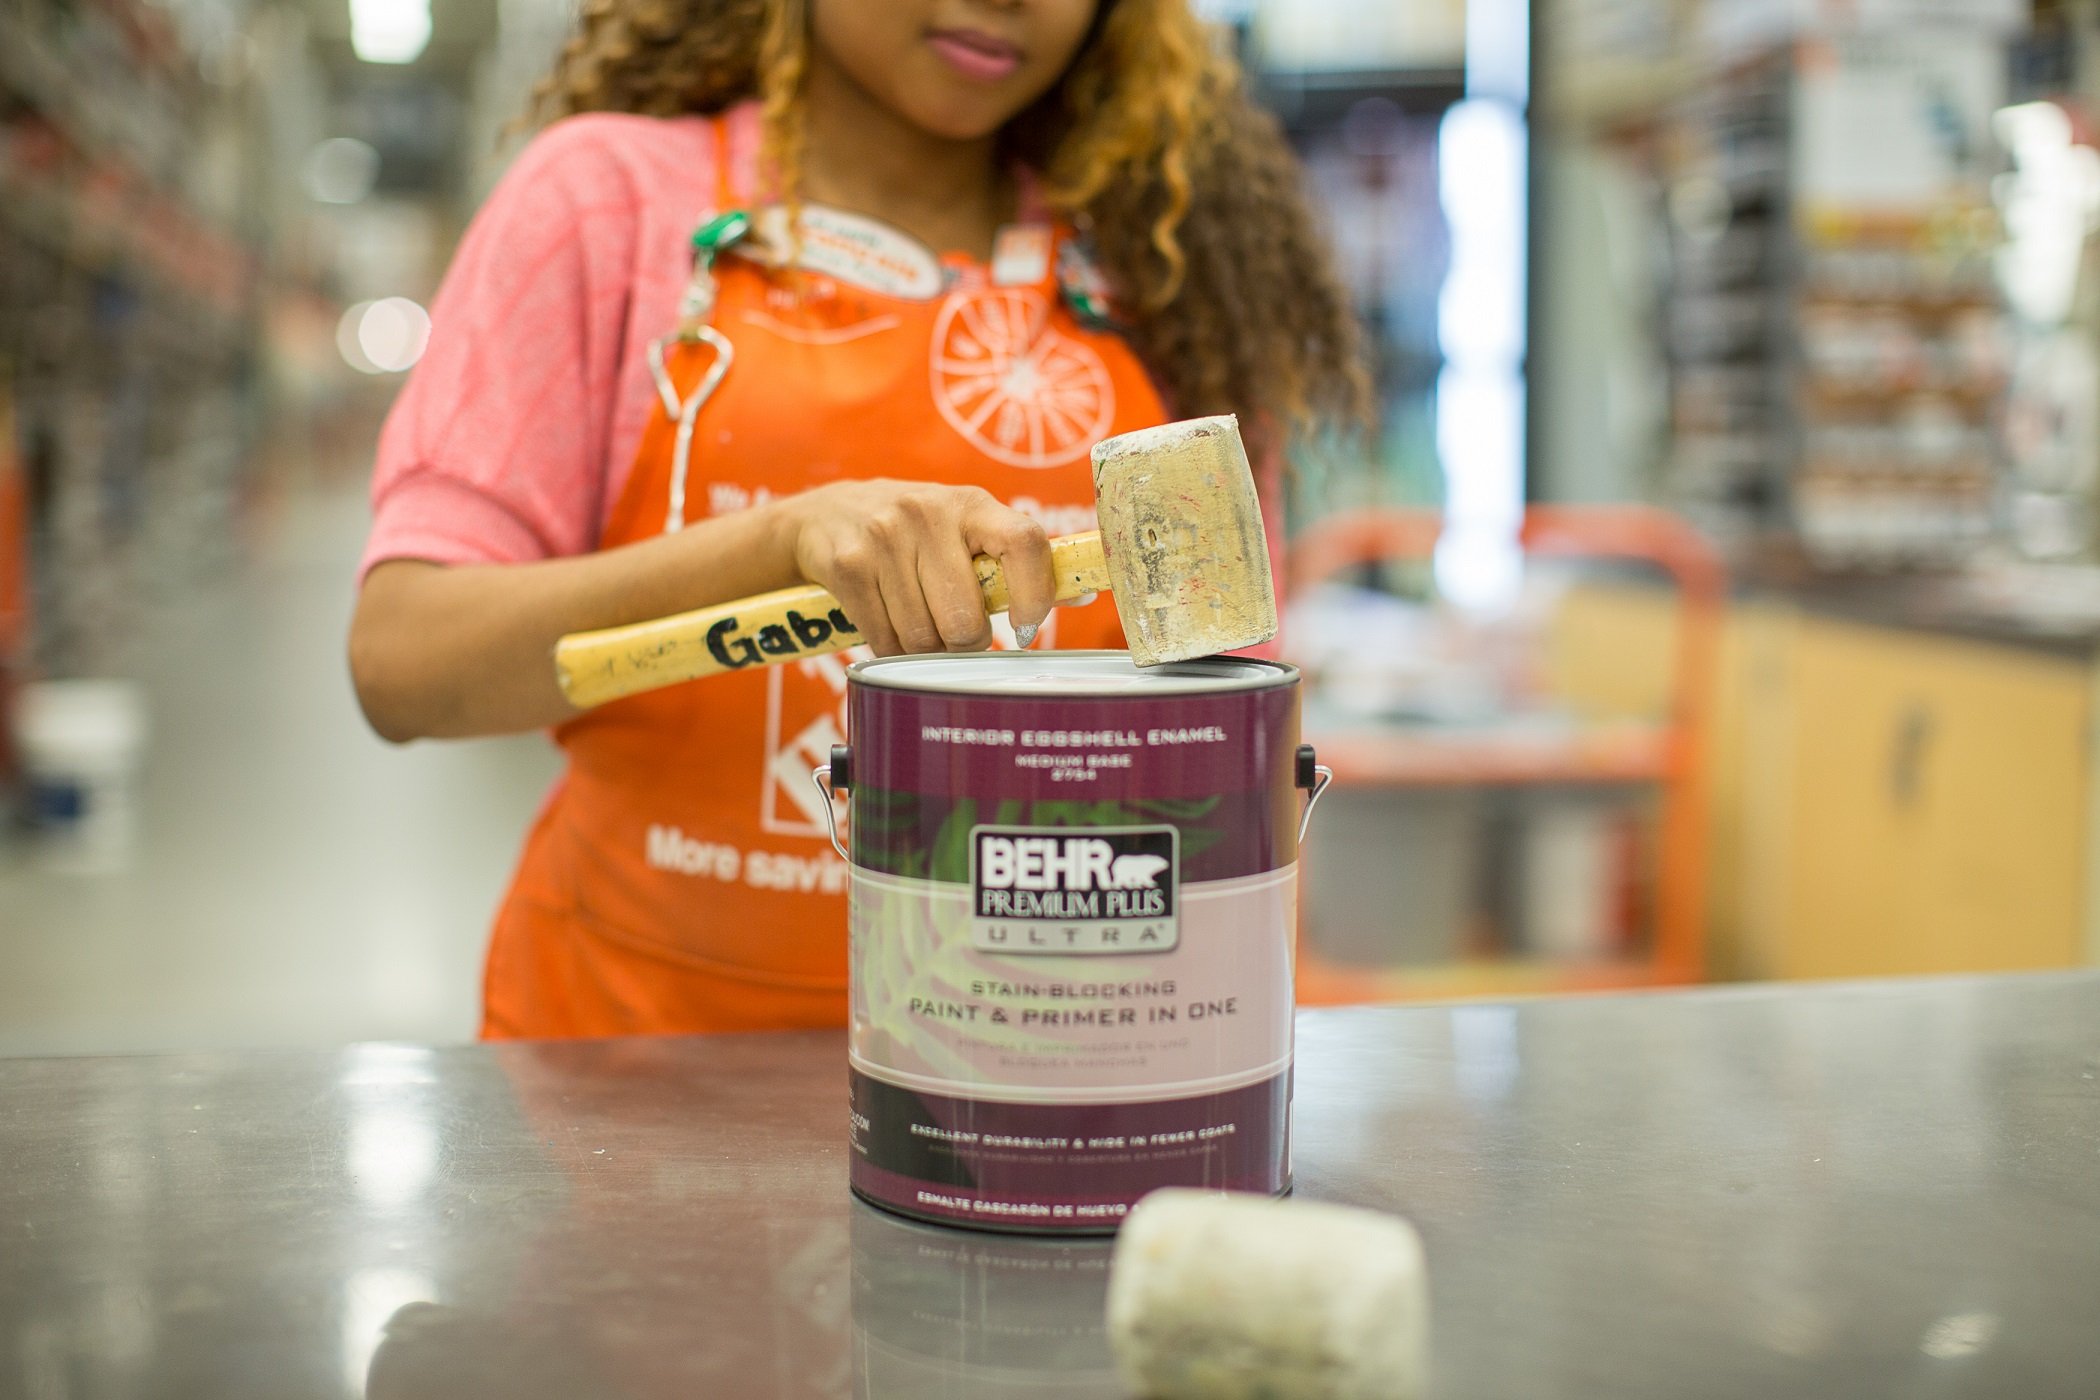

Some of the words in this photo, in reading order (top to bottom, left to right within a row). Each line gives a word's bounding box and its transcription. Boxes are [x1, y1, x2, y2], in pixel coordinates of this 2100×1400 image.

[922, 727, 1015, 746] INTERIOR
[1021, 730, 1142, 747] EGGSHELL
[1147, 726, 1227, 746] ENAMEL
[1015, 754, 1083, 768] MEDIUM
[1087, 754, 1132, 768] BASE
[982, 837, 1114, 890] BEHR
[982, 889, 1099, 917] PREMIUM
[1106, 889, 1165, 916] PLUS
[971, 980, 1177, 998] STAIN-BLOCKING
[910, 998, 979, 1020] PAINT
[989, 1007, 1008, 1024] &
[1022, 1008, 1136, 1026] PRIMER
[1150, 1006, 1177, 1023] IN
[1188, 997, 1237, 1020] ONE
[910, 1123, 978, 1143] EXCELLENT
[982, 1134, 1068, 1149] DURABILITY
[1129, 1135, 1147, 1147] IN
[917, 1190, 970, 1211] ESMALTE
[1053, 1205, 1073, 1217] DE
[1076, 1203, 1127, 1216] HUEVO
